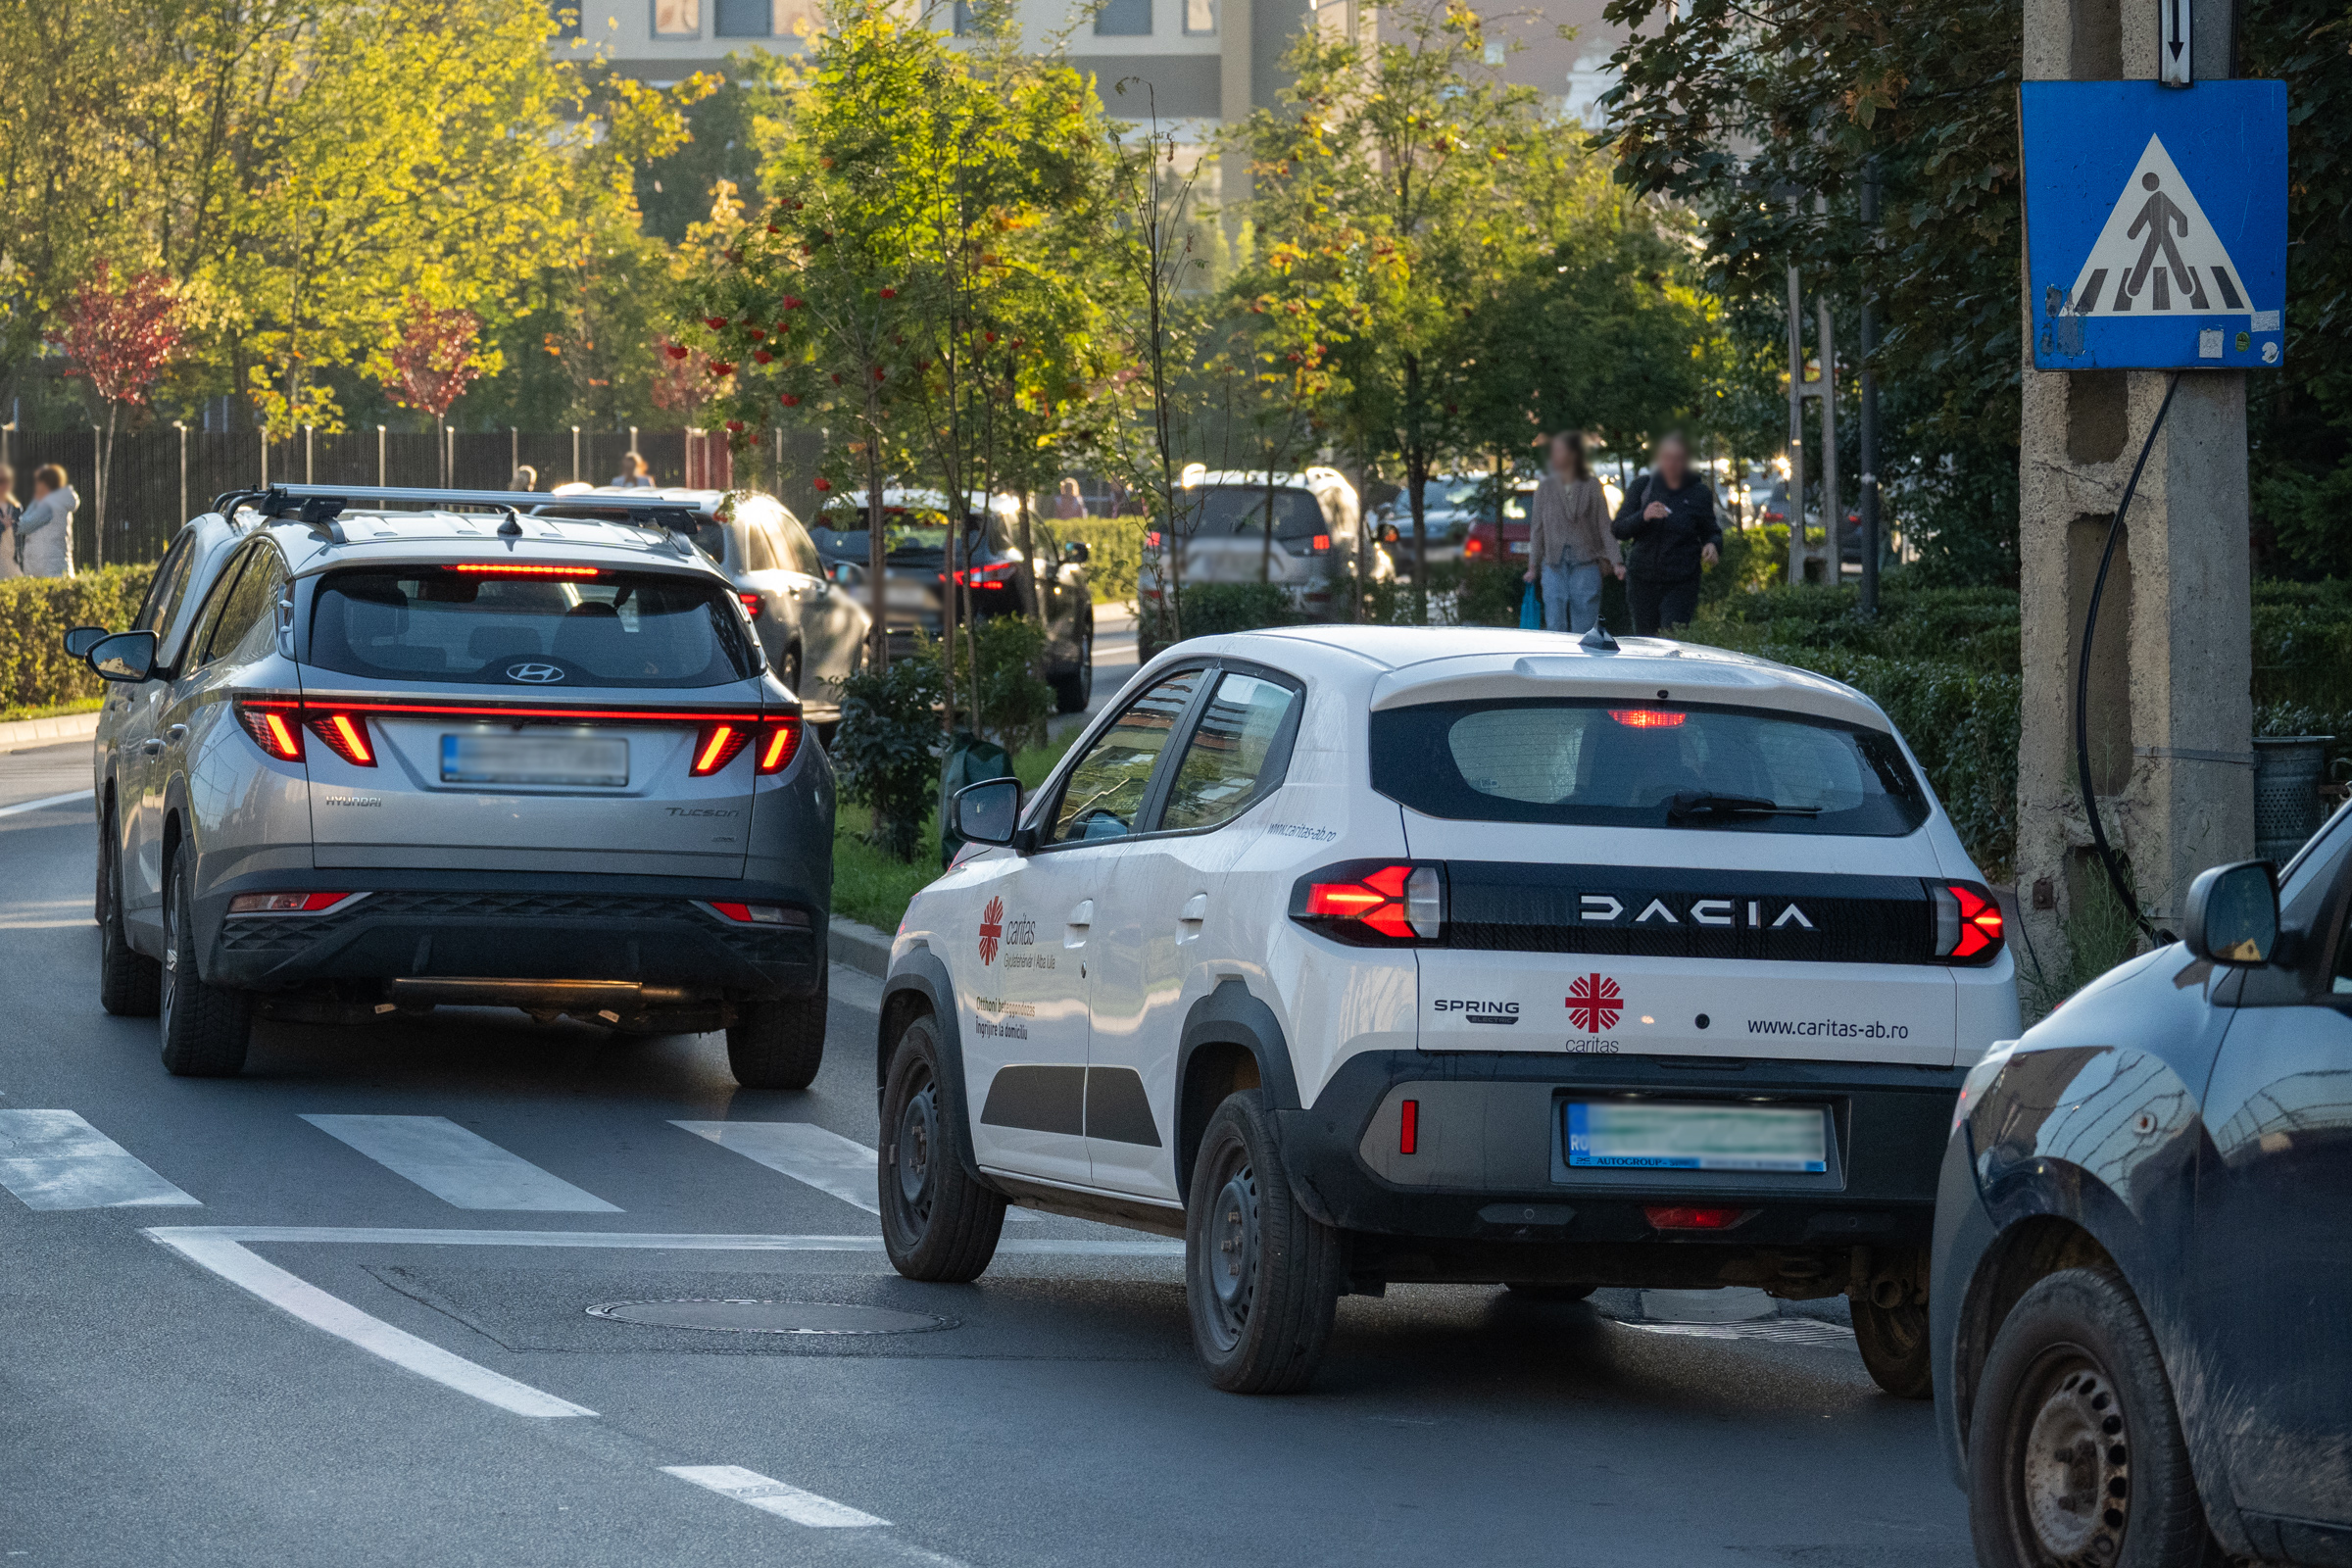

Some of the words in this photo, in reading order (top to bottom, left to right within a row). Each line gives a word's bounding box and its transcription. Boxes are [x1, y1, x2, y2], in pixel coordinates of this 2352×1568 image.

[325, 796, 382, 808] HYUNDAI
[1267, 822, 1337, 842] www.caritas-ab.ro
[1580, 895, 1815, 929] DACIA
[1005, 912, 1036, 946] caritas
[976, 996, 998, 1012] Otthoni
[1434, 999, 1520, 1014] SPRING
[998, 1021, 1004, 1038] la
[1004, 1022, 1028, 1041] domiciliu
[1747, 1018, 1909, 1040] www.caritas-ab.ro
[1565, 1035, 1620, 1054] caritas
[1596, 1156, 1662, 1167] AUTOGROUP
